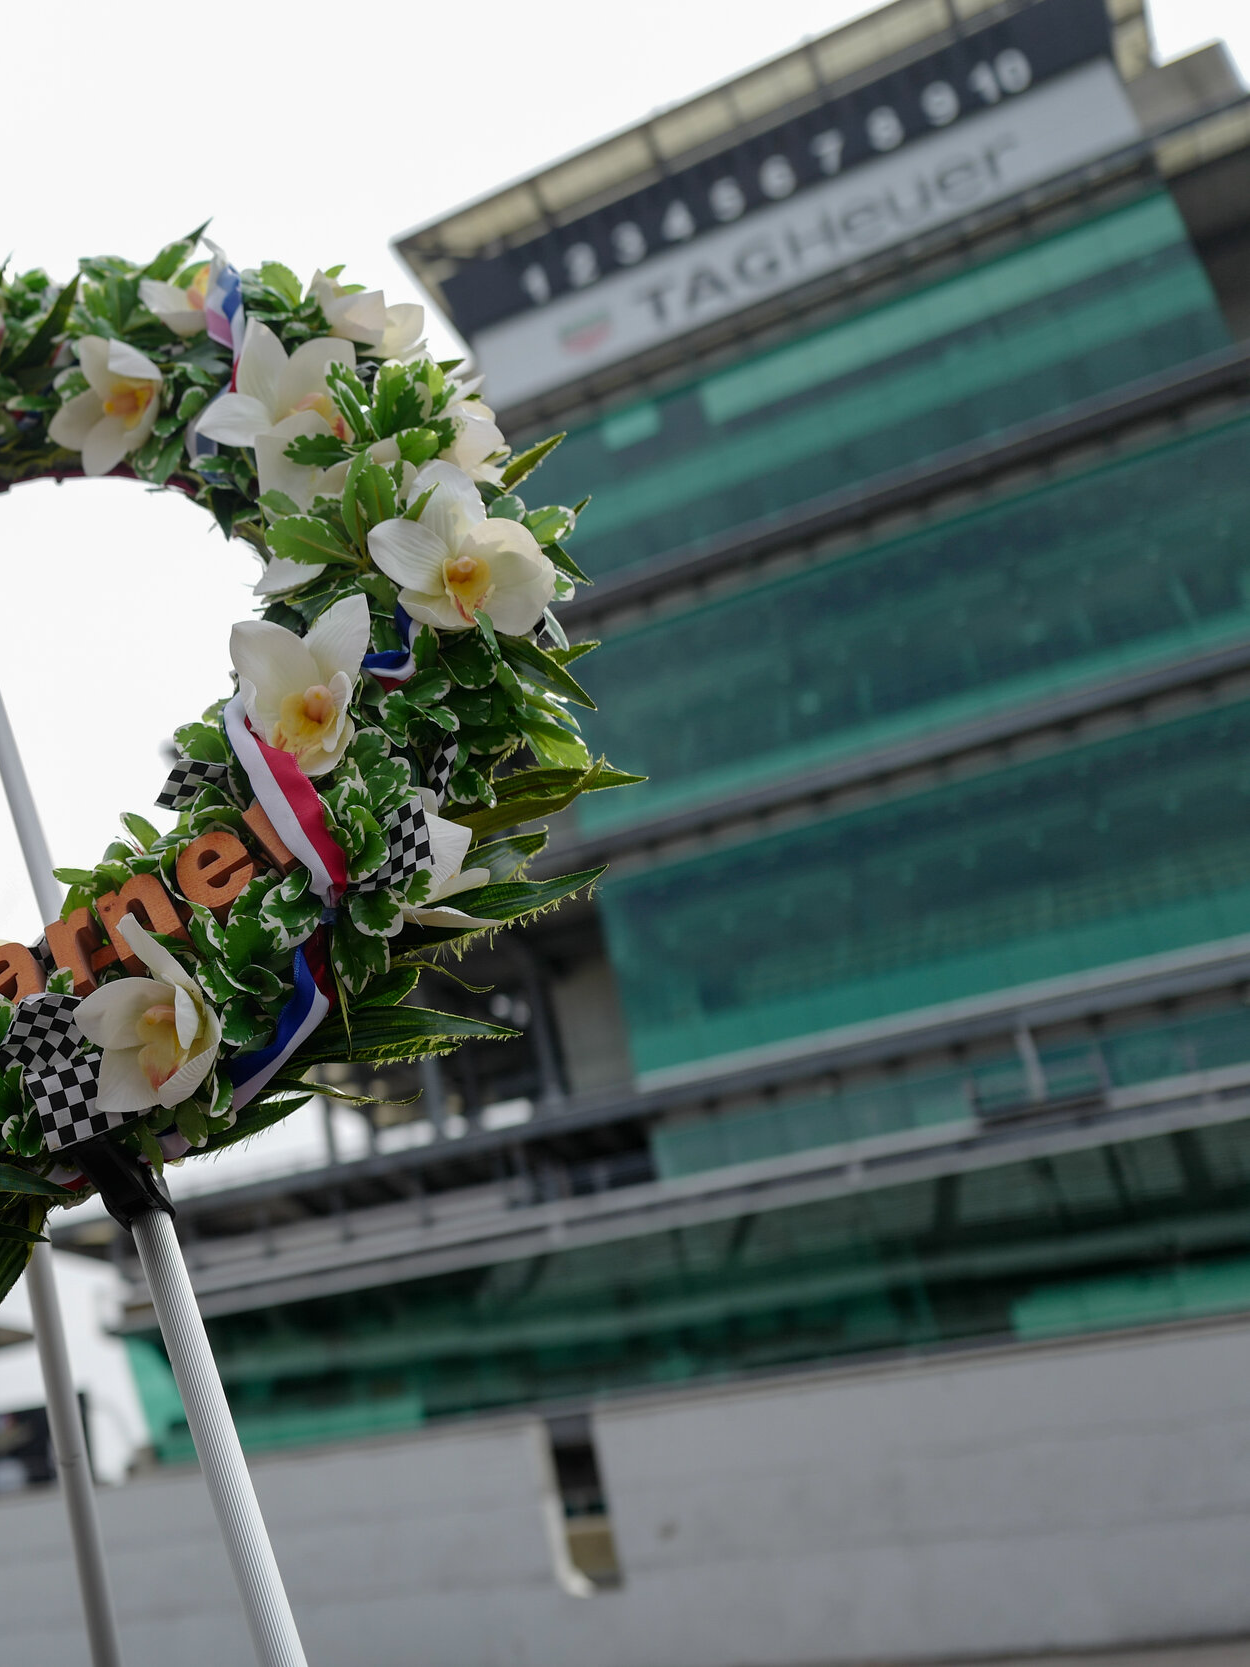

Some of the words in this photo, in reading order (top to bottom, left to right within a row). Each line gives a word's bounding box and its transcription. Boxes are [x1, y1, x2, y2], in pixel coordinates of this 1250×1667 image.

[518, 262, 550, 304] 1
[564, 242, 598, 288] 2
[611, 220, 646, 267] 3
[661, 199, 696, 241] 4
[708, 176, 745, 222] 5
[759, 153, 797, 200] 6
[810, 129, 844, 176] 7
[865, 105, 904, 151] 8
[921, 80, 959, 127] 9
[967, 47, 1032, 104] 10
